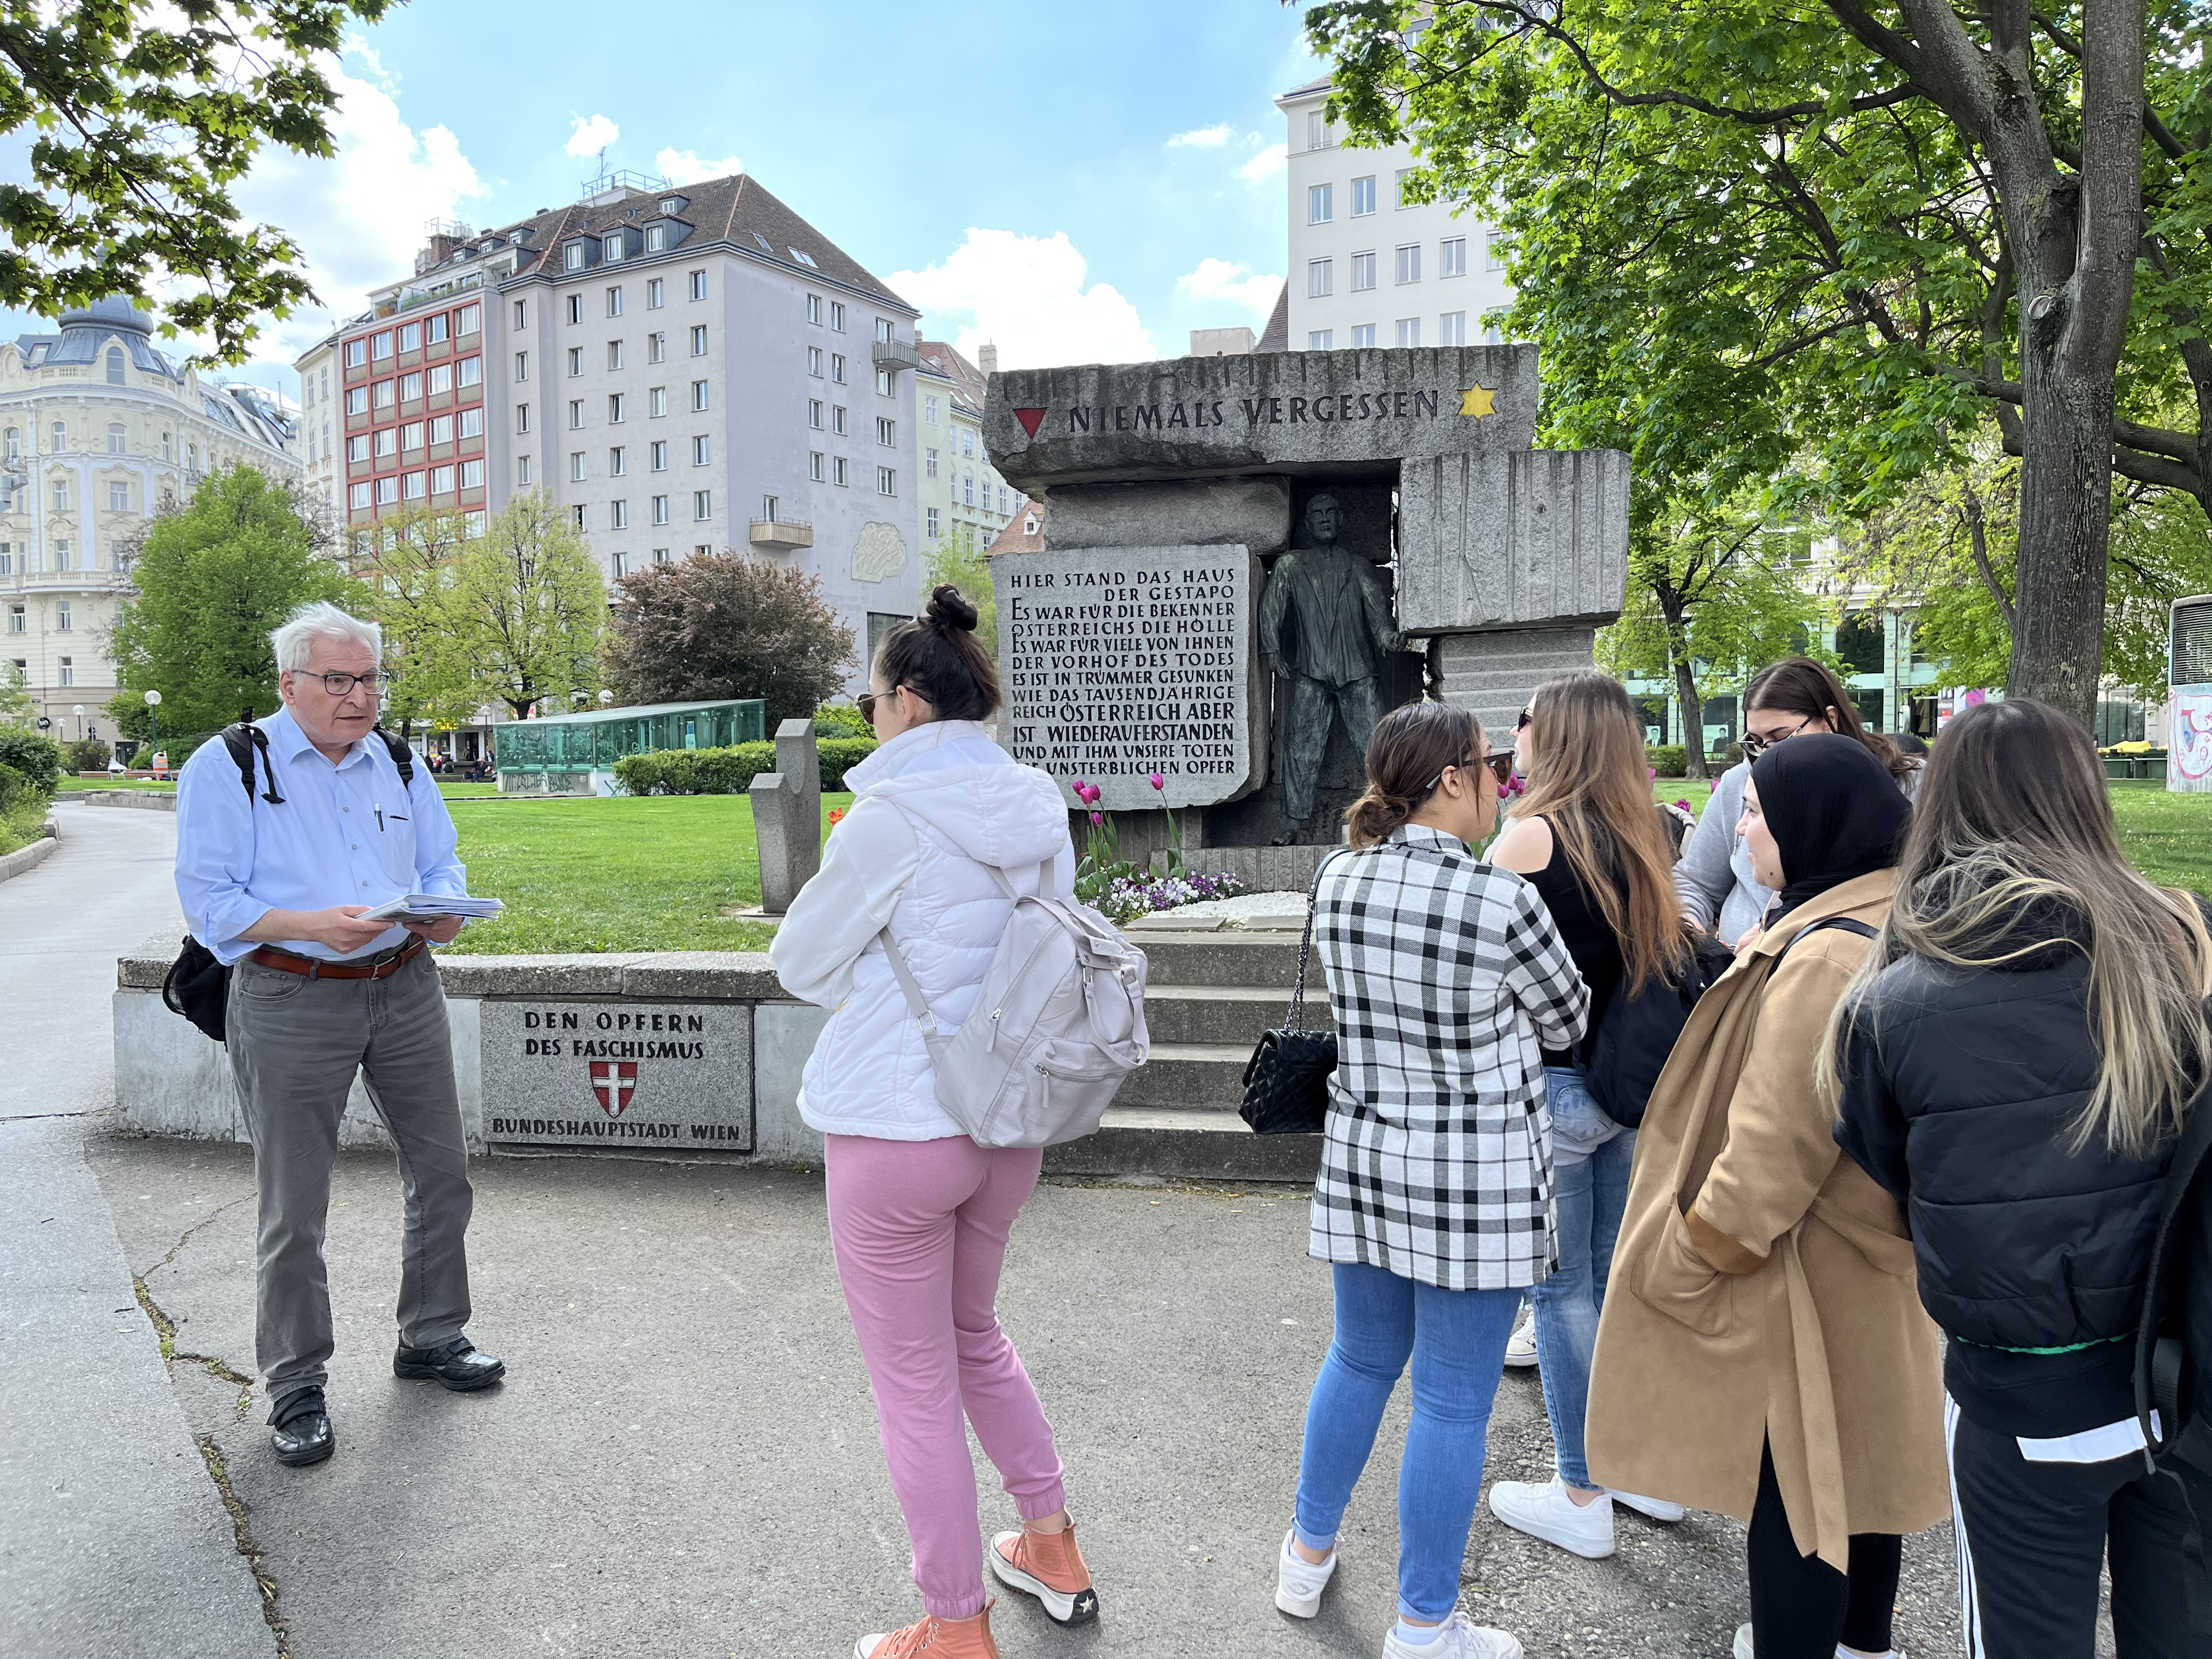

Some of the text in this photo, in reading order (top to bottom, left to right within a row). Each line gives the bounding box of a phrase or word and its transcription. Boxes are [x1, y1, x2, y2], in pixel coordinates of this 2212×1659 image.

[1069, 390, 1438, 433] NIEMALS VERGESSEN
[1011, 568, 1234, 588] HIER STAND DAS HAUS
[1104, 585, 1234, 602] DER GESTAPO
[1035, 606, 1075, 620] WAR
[1118, 604, 1144, 618] DIE
[1150, 602, 1235, 617] BEKENNER
[1142, 620, 1171, 634] DIE
[1030, 639, 1066, 654] WAR
[1103, 638, 1142, 652] VIELE
[1146, 637, 1178, 651] VON
[1185, 636, 1233, 650] IHNEN
[1012, 652, 1234, 670] DER VORHOF DES TODES
[1012, 673, 1026, 686] ES
[1031, 673, 1049, 686] IST
[1055, 672, 1070, 685] IN
[1158, 669, 1233, 684] GESUNKEN
[1012, 685, 1235, 702] WIE DAS TAUSENDJÄHRIGE
[1013, 705, 1056, 719] REICH
[1186, 702, 1235, 720] ABER
[1013, 723, 1234, 743] IST WIEDERAUFERSTANDEN
[1012, 744, 1233, 759] UND MIT IHM UNSERE TOTEN
[1046, 760, 1180, 775] UNSTERBLICHEN
[1186, 760, 1235, 774] OPFER
[524, 1011, 703, 1034] DEN OPFERN
[526, 1038, 703, 1059] DES FASCHISMUS
[492, 1118, 740, 1141] BUNDESHAUPTSTADT WIEN
